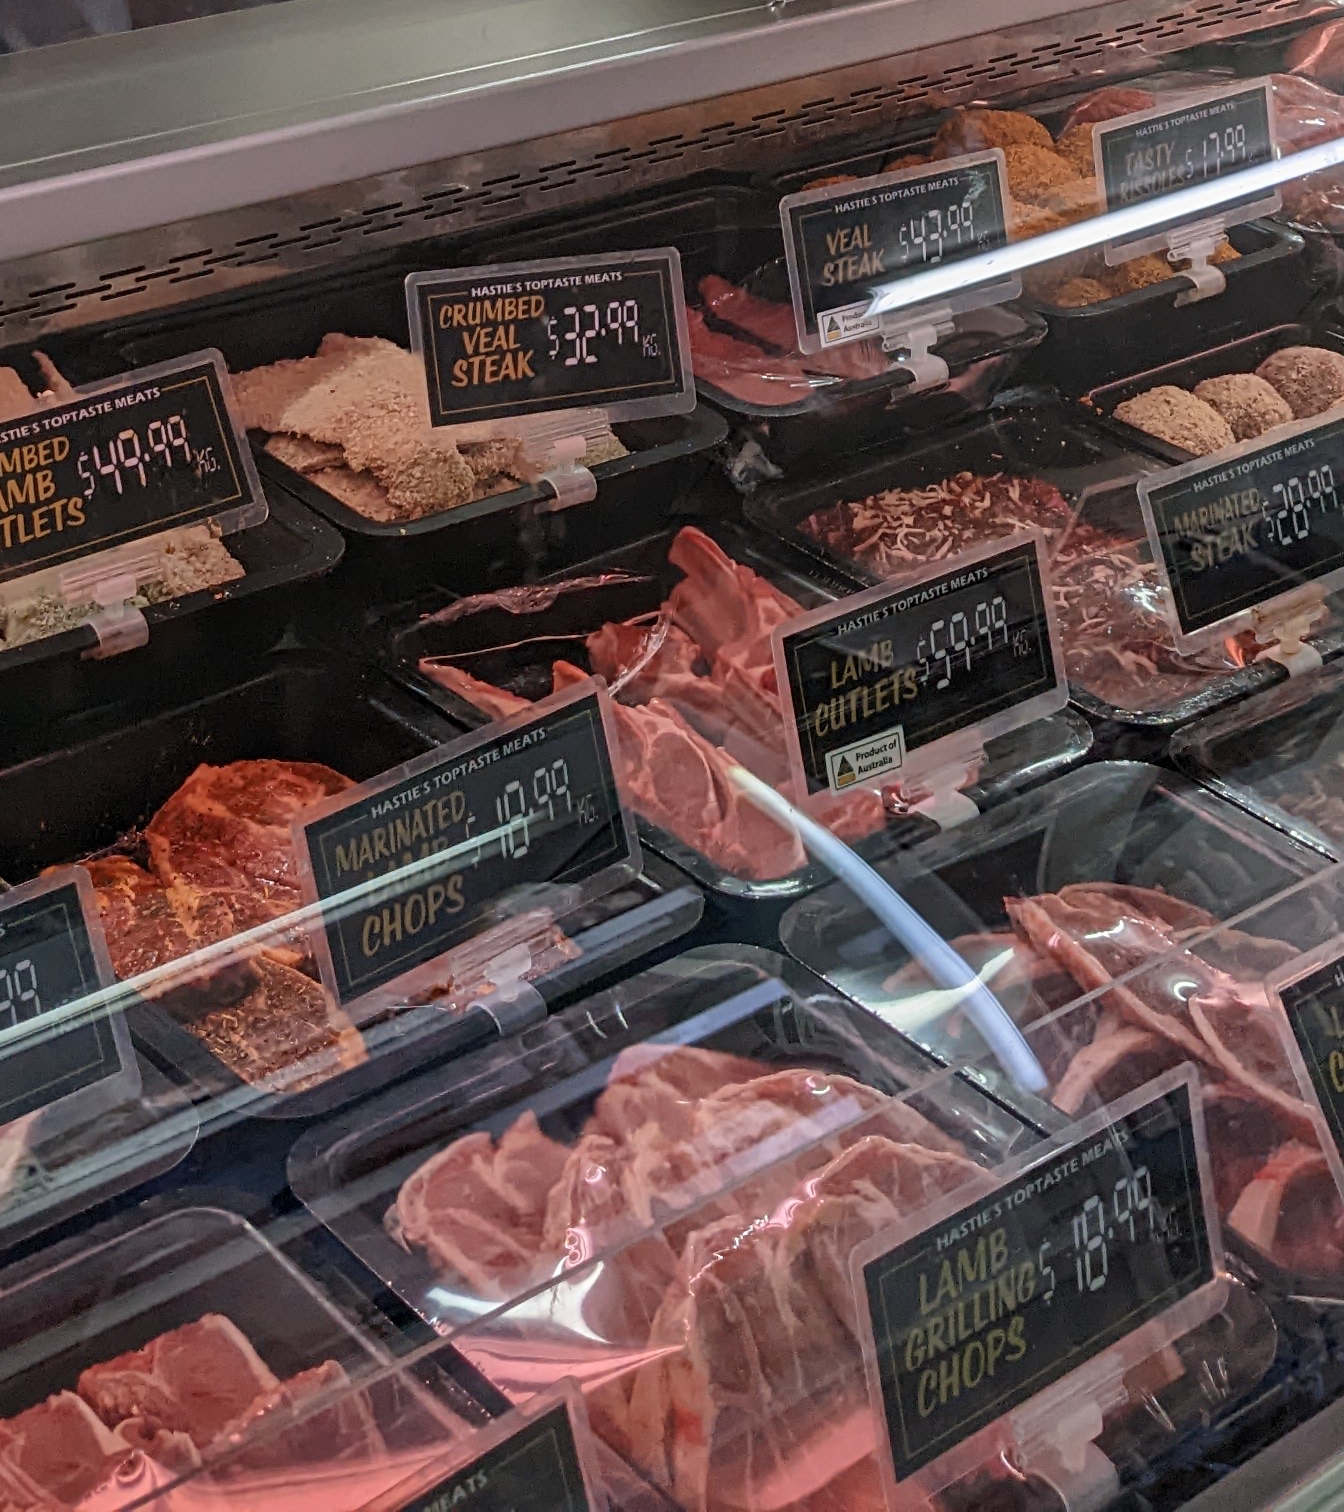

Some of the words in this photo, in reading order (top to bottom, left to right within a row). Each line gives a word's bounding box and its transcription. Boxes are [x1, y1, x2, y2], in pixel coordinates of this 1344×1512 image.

[1124, 140, 1175, 176] TASTY
[825, 222, 873, 256] VEAL
[899, 201, 974, 264] $43.99
[821, 248, 886, 287] STEAK
[439, 295, 545, 329] CRUMBED
[463, 324, 521, 355] VEAL
[548, 300, 639, 366] $32.99
[451, 349, 536, 388] STEAK
[42, 400, 112, 432] TOPTASTE
[77, 415, 192, 499] $49.99
[1173, 488, 1261, 534] MARINATED
[1262, 464, 1338, 546] $28.99
[1190, 522, 1260, 572] STEAK
[890, 585, 949, 615] TOPTASTE
[831, 640, 894, 690] LAMB
[917, 596, 1008, 689] $59.99
[813, 667, 919, 738] CUTLETS
[370, 785, 432, 820] HASTIE'S
[432, 749, 501, 789] TOPTASTE
[502, 727, 547, 756] MEATS
[856, 743, 886, 760] Product
[887, 739, 897, 750] of
[335, 790, 467, 877] MARINATED
[361, 874, 466, 958] CHOPS
[918, 1227, 1009, 1317] LAMB
[903, 1261, 1036, 1372] GRILLING
[918, 1316, 1027, 1419] CHOPS
